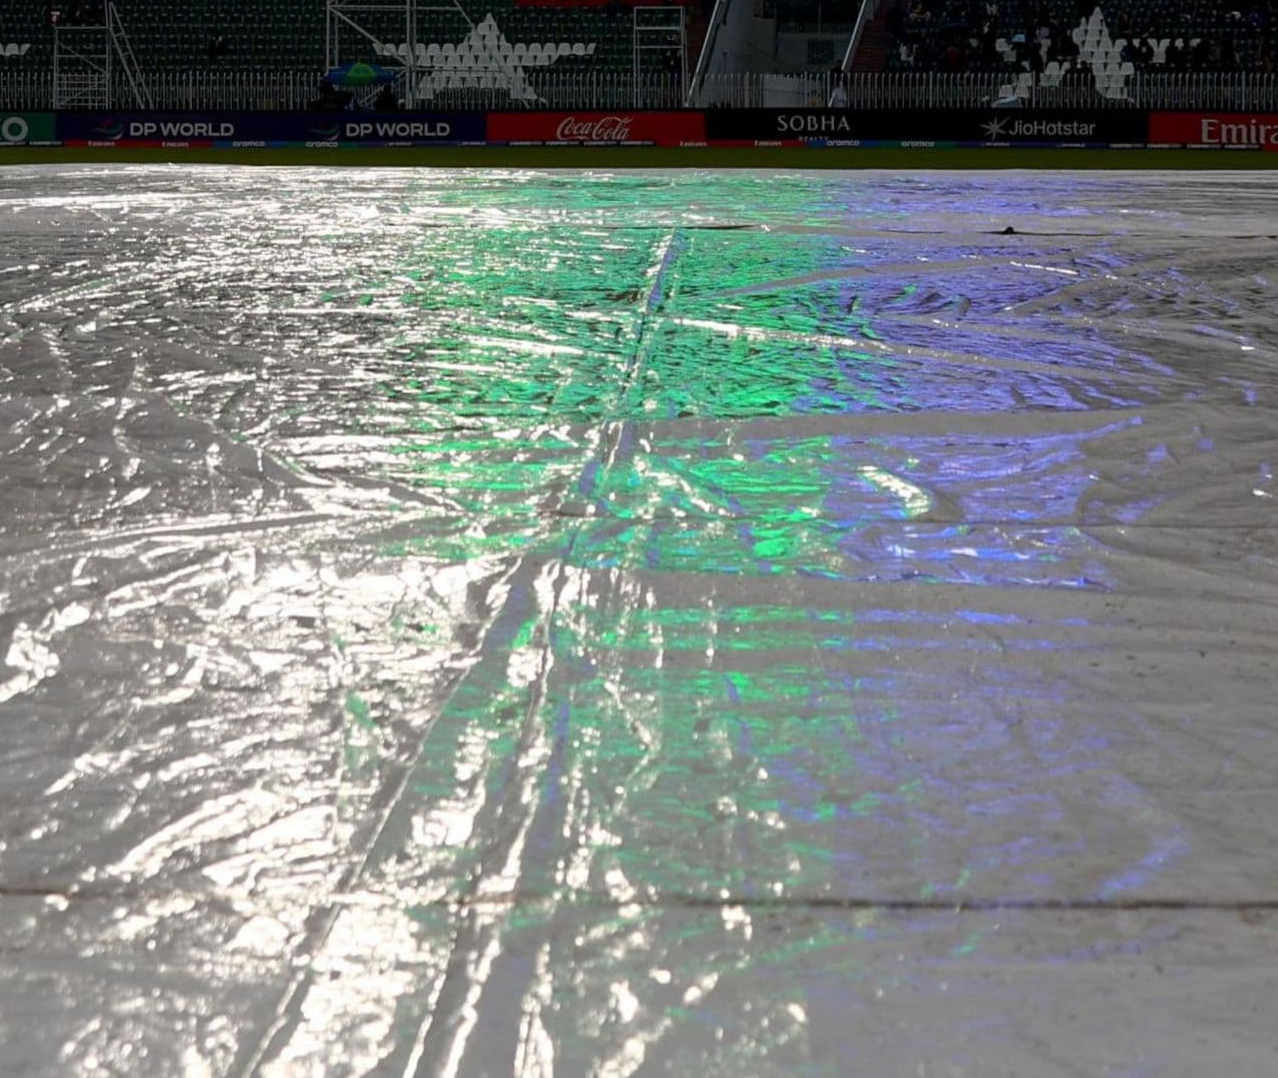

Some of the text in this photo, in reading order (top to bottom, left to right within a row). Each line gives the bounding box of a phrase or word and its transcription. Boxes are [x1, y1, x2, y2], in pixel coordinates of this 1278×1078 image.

[130, 123, 234, 137] DP WORLD
[346, 123, 450, 137] DP WORLD
[556, 116, 633, 140] Coca-Cola
[777, 115, 851, 131] SOBHA
[1009, 120, 1096, 135] JioHotstar
